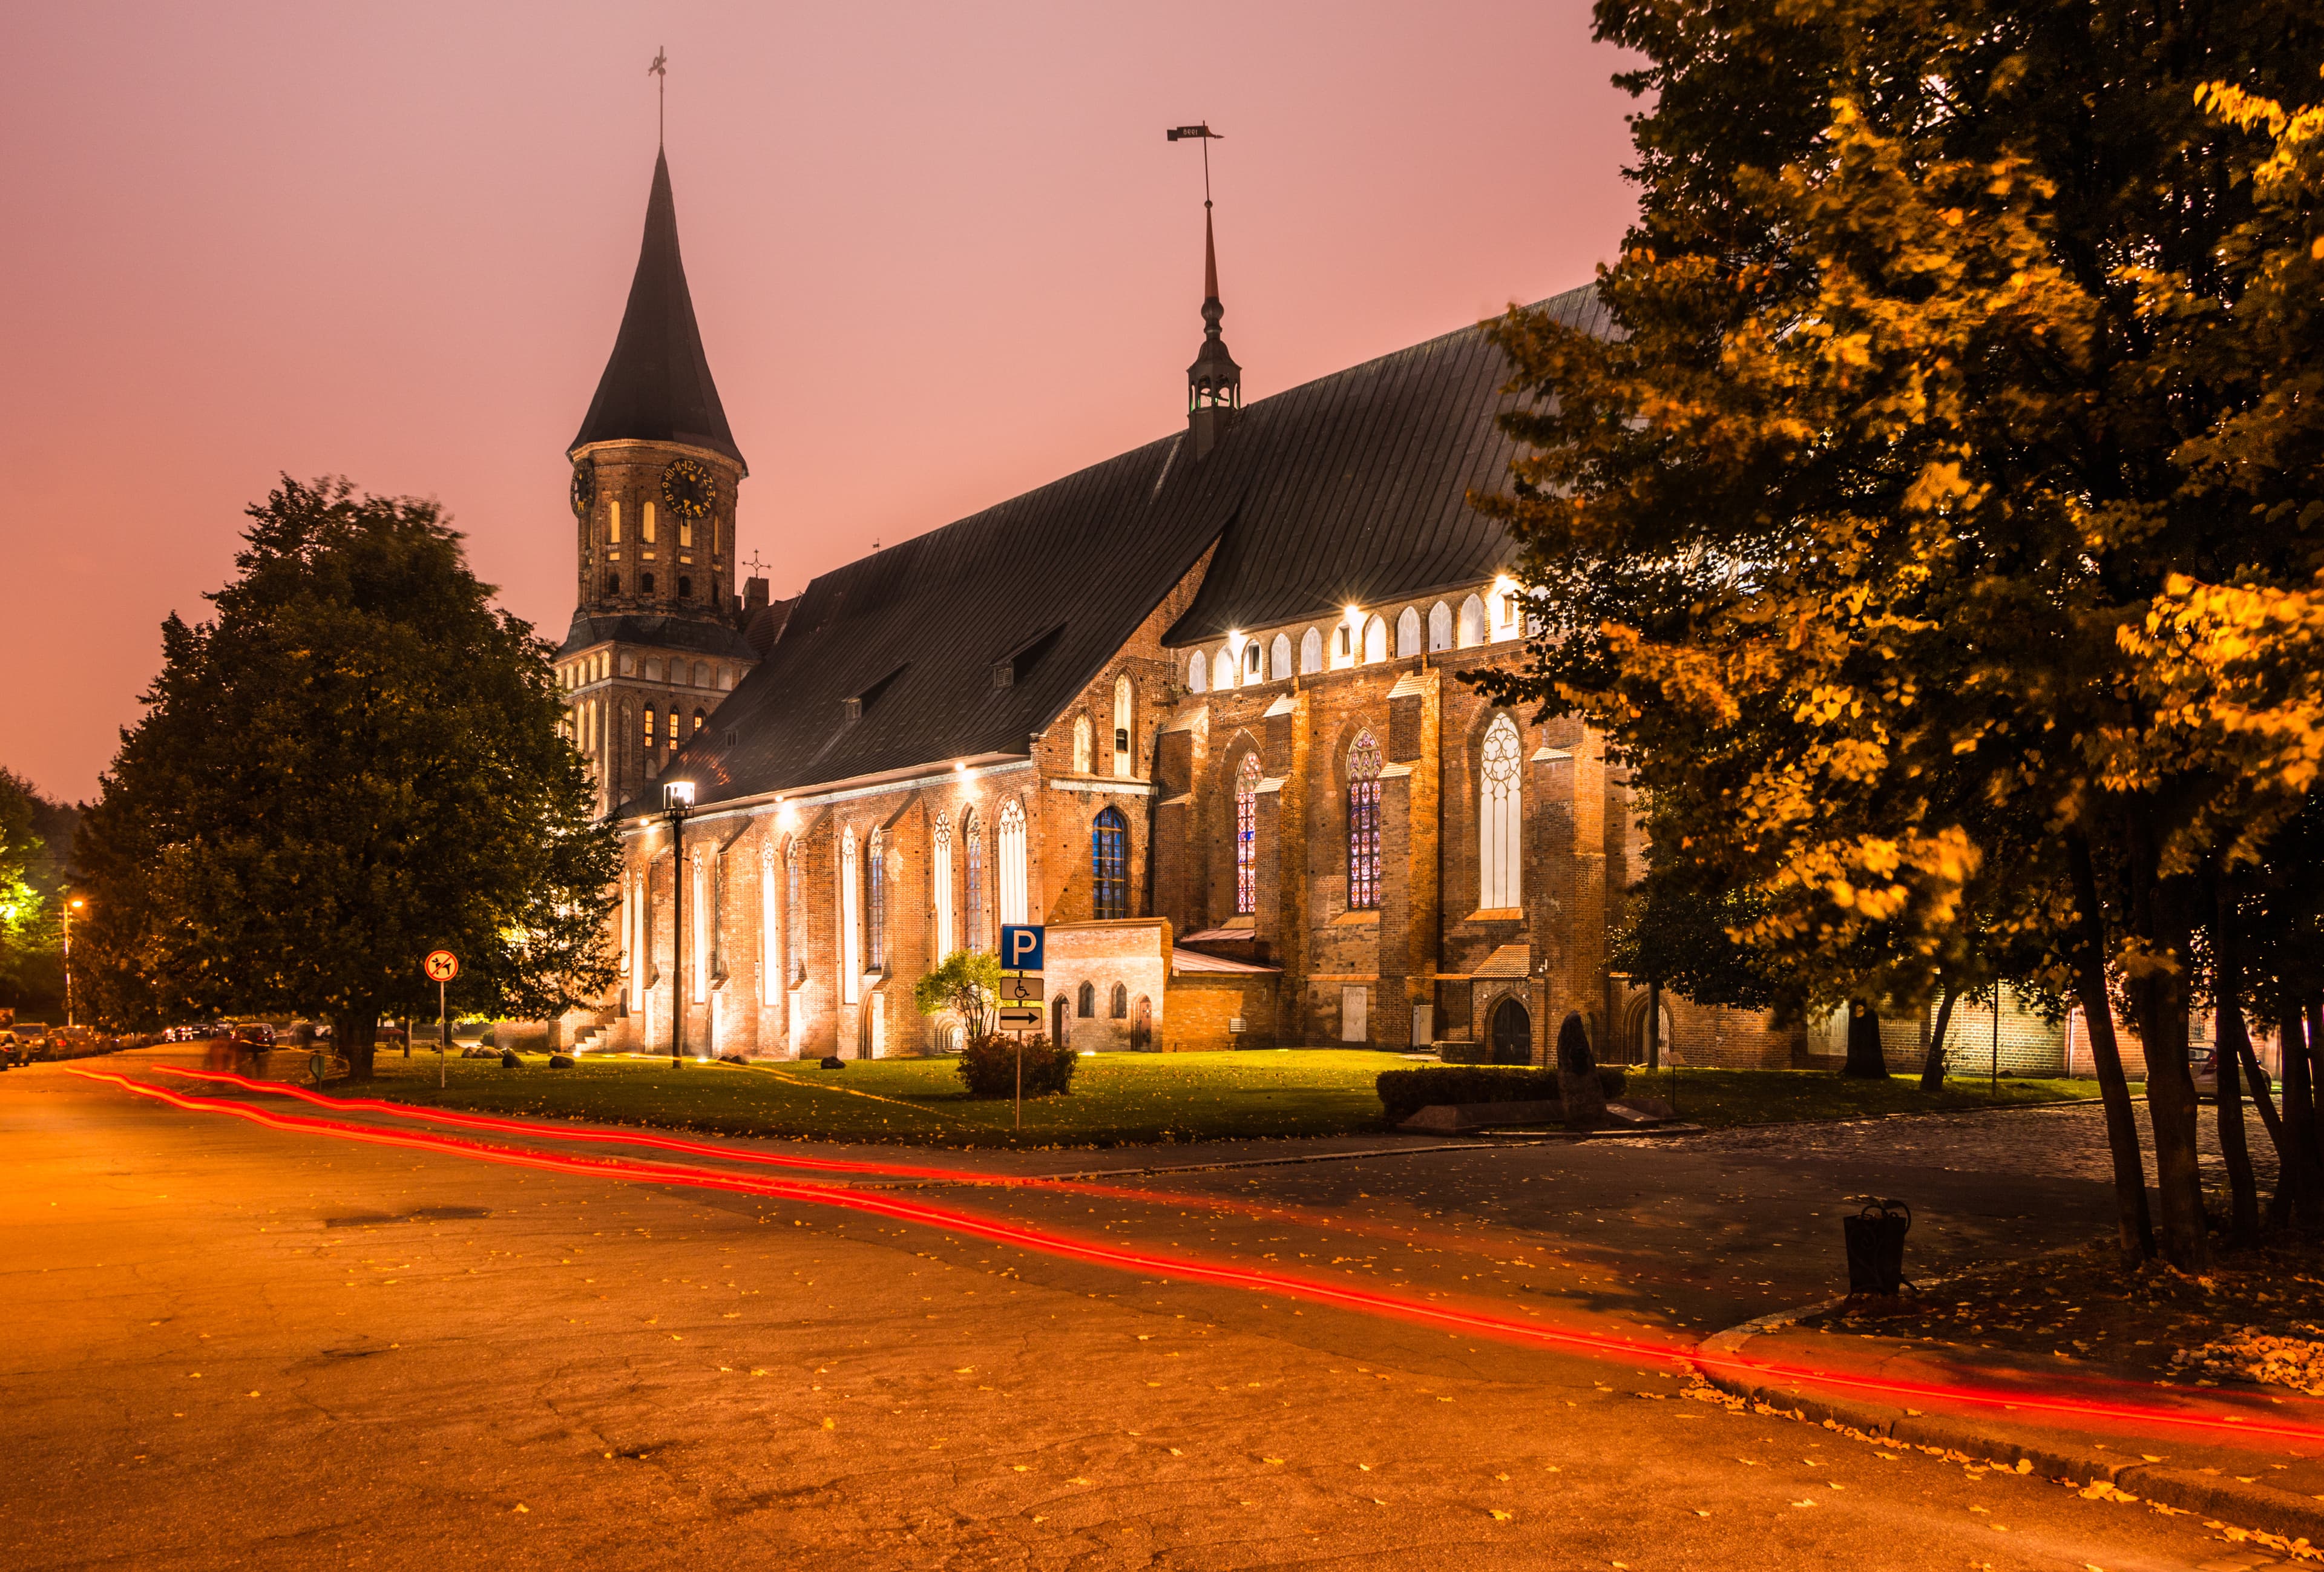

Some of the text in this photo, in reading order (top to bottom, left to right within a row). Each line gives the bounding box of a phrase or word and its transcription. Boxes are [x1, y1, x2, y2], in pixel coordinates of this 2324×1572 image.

[674, 461, 681, 472] 11
[684, 460, 694, 471] 12
[664, 469, 674, 479] 10
[703, 476, 714, 485] 2
[673, 505, 681, 513] 7
[1013, 930, 1037, 965] P
